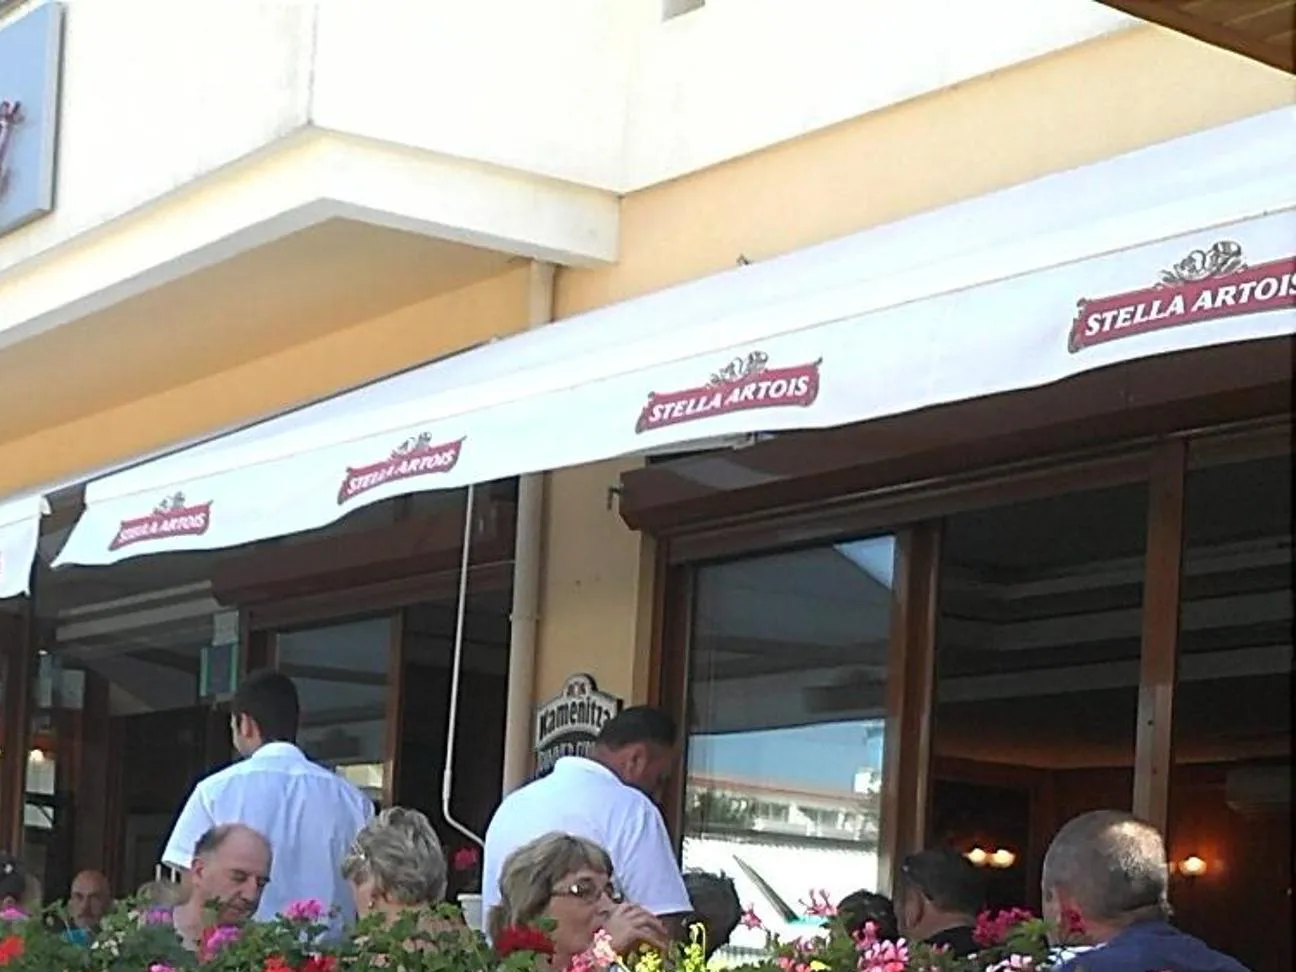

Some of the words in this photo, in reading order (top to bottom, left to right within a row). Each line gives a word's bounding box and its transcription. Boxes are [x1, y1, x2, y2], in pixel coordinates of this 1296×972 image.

[1084, 294, 1185, 337] STELLA
[648, 392, 722, 423] STELLA
[723, 375, 811, 406] ARTOIS
[394, 449, 457, 475] ARTOIS
